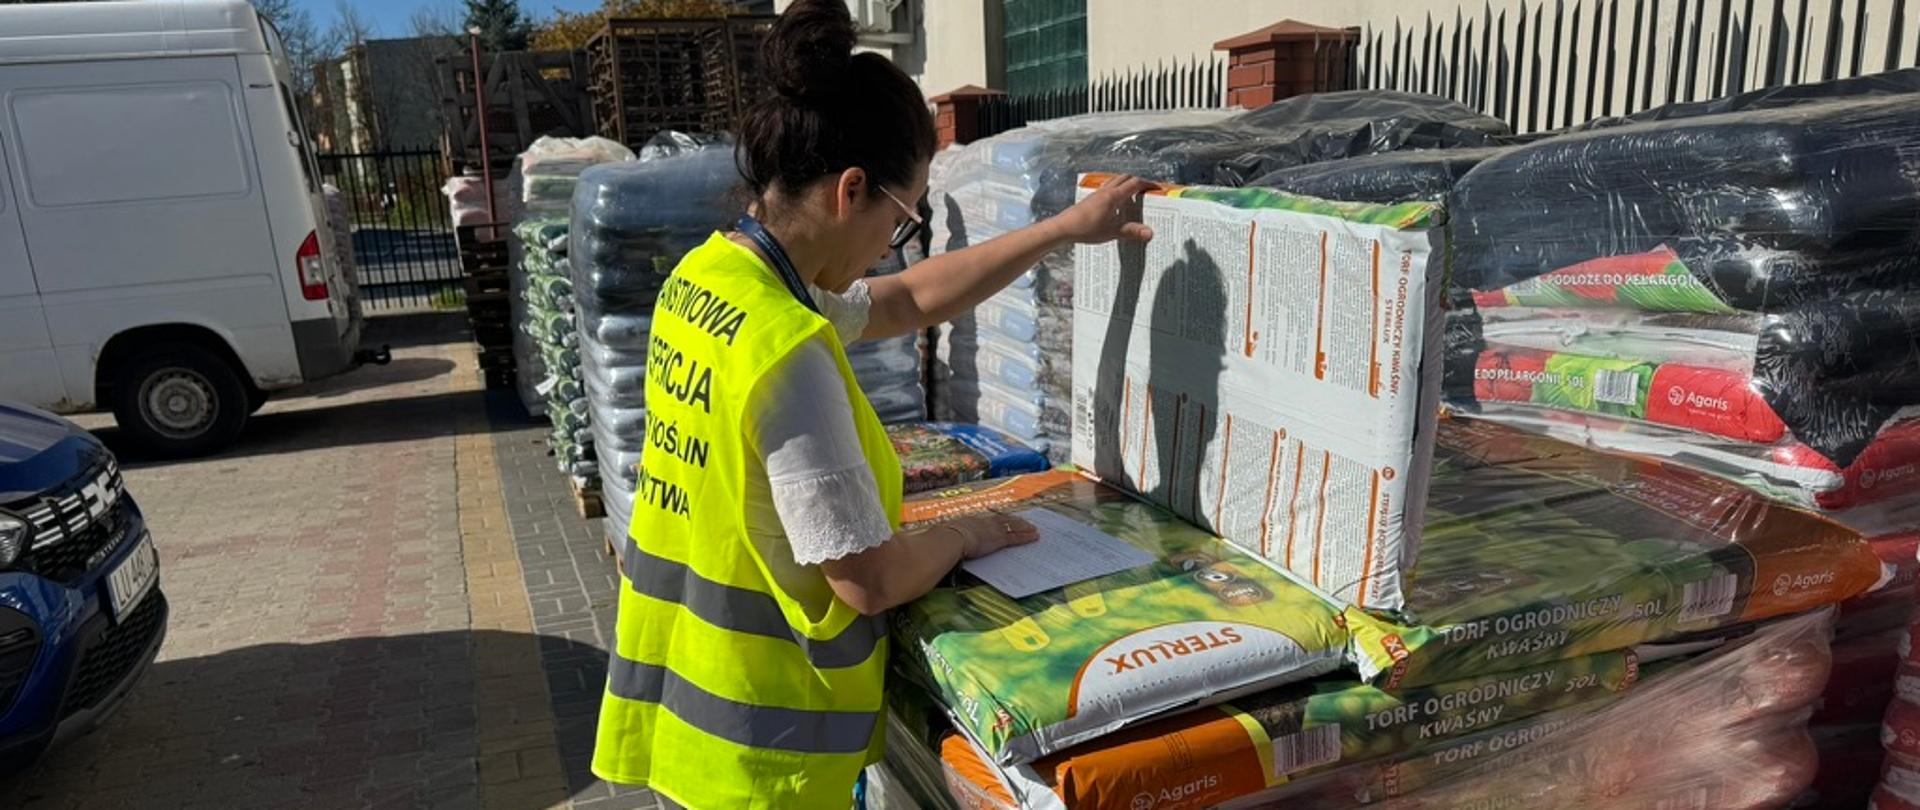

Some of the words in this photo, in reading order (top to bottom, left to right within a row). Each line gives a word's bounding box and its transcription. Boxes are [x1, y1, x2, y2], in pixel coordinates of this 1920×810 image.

[1383, 298, 1394, 344] STERLUX
[1686, 391, 1728, 411] Agaris
[1877, 463, 1915, 481] Agaris
[1791, 570, 1834, 588] Agaris
[1440, 620, 1489, 645] TORF
[1495, 595, 1622, 635] OGRODNICZY
[1104, 626, 1243, 674] STERLUX
[1486, 630, 1570, 660] KWAŚNY
[1365, 702, 1420, 730] TORF
[1424, 670, 1555, 715] OGRODNICZY
[1419, 704, 1504, 739] KWAŚNY
[1434, 741, 1484, 765] TORF
[1158, 775, 1218, 804] Agaris
